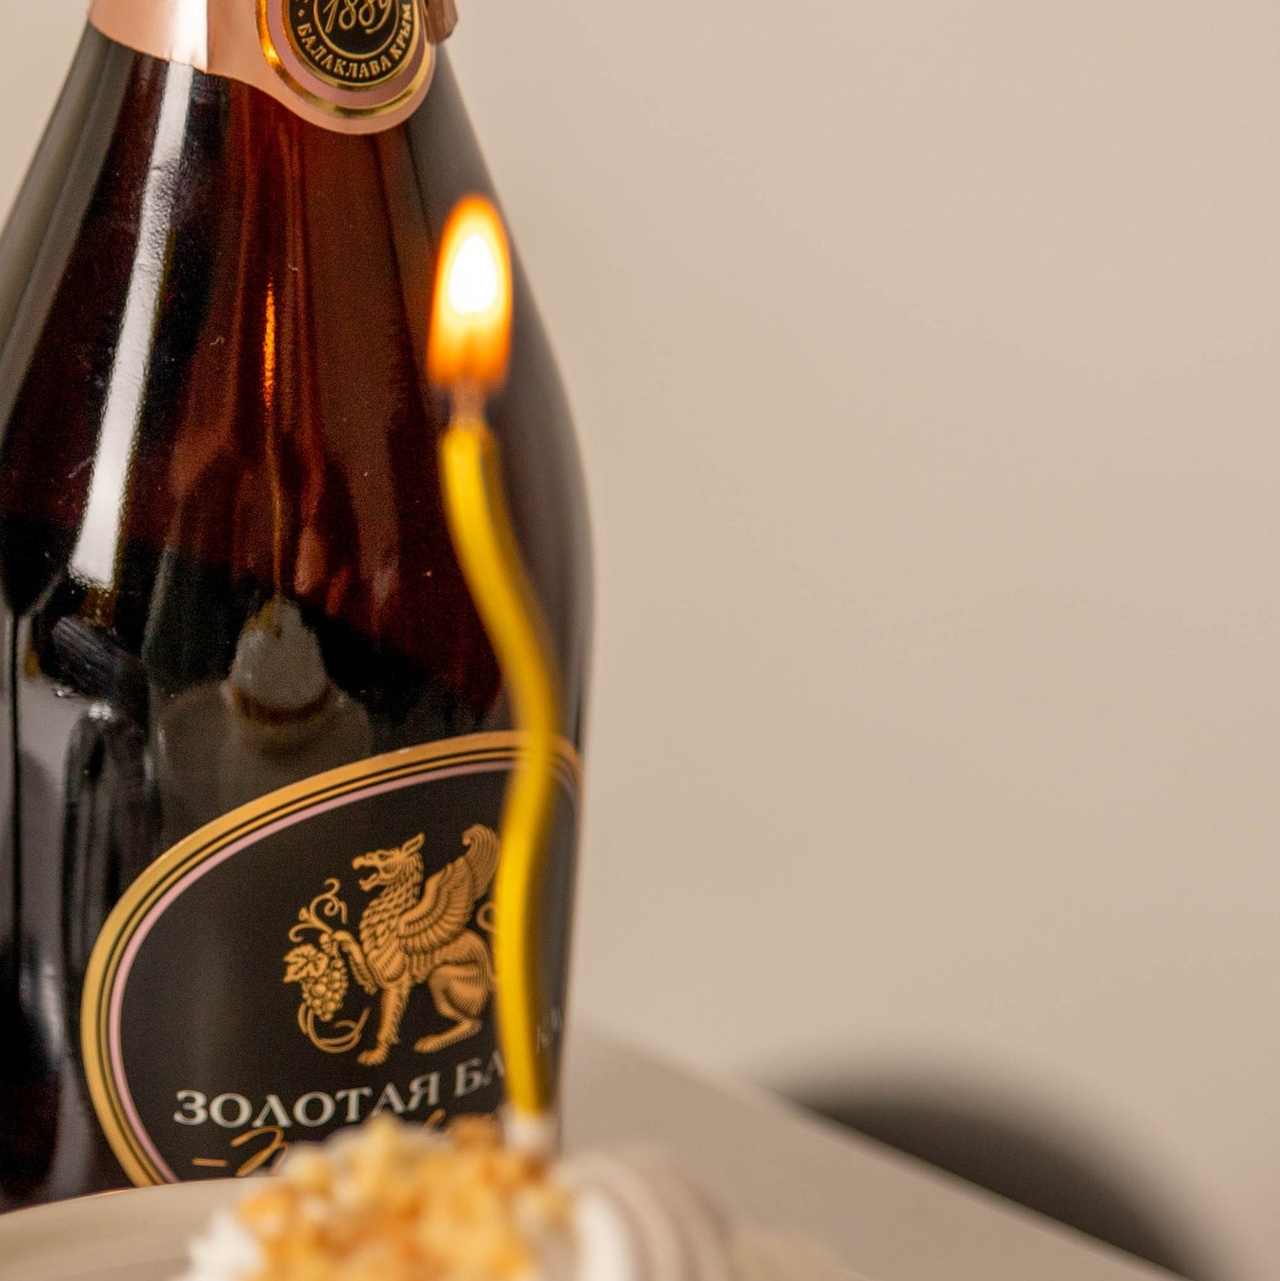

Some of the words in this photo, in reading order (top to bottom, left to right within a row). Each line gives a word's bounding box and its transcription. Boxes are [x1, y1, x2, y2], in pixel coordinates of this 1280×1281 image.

[297, 22, 392, 79] БАЛАКЛАВА
[392, 3, 413, 61] КРЫМ
[173, 1071, 441, 1128] ЗОЛОТАЯ
